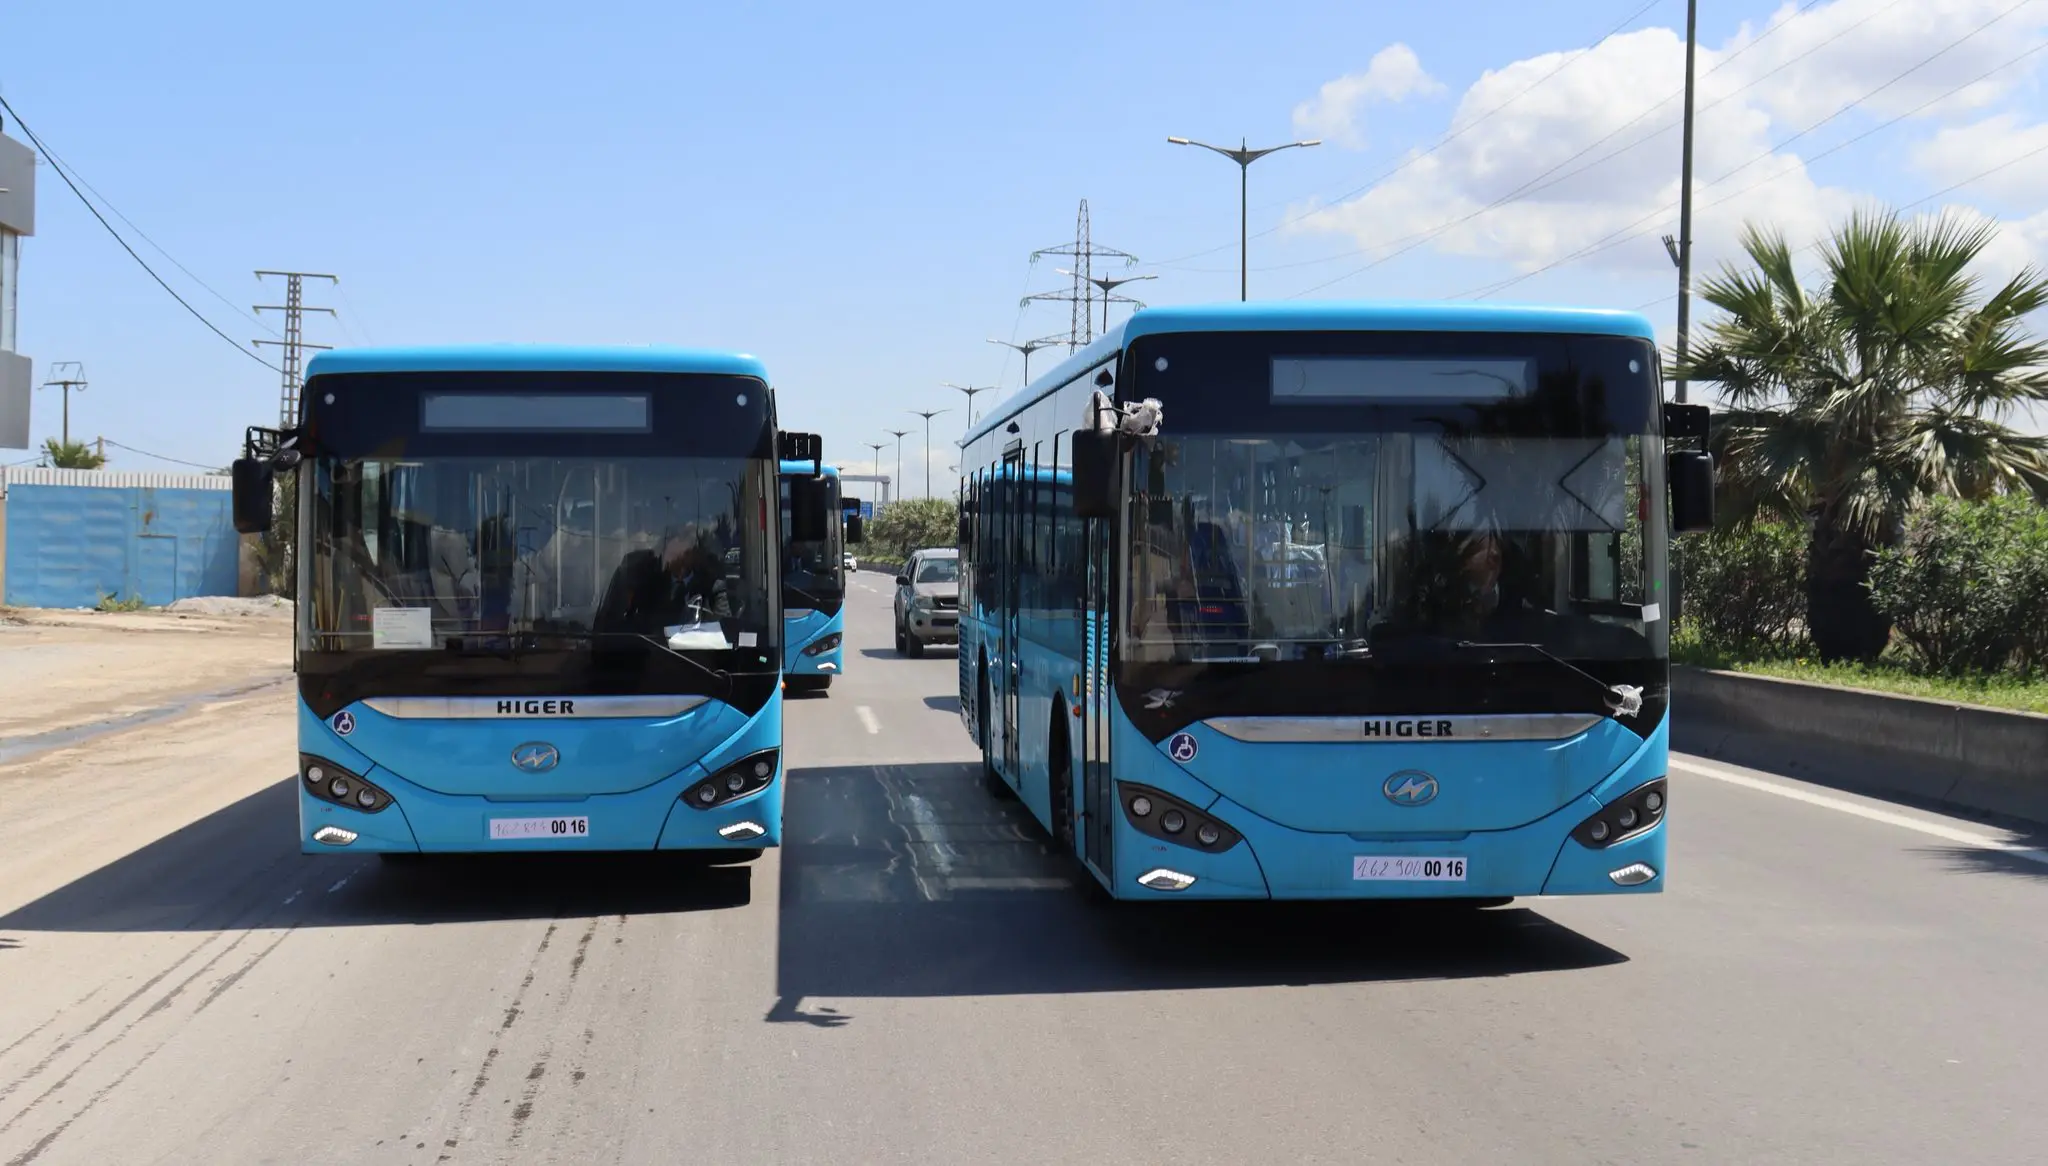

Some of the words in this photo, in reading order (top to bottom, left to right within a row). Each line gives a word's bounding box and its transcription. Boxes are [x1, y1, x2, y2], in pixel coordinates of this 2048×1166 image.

[497, 700, 574, 714] HIGER
[1364, 720, 1453, 737] HIGER
[551, 819, 566, 834] 00
[571, 819, 586, 834] 16
[1358, 859, 1389, 877] 162
[1395, 859, 1421, 877] 900
[1424, 860, 1442, 877] 00
[1446, 860, 1463, 877] 16
